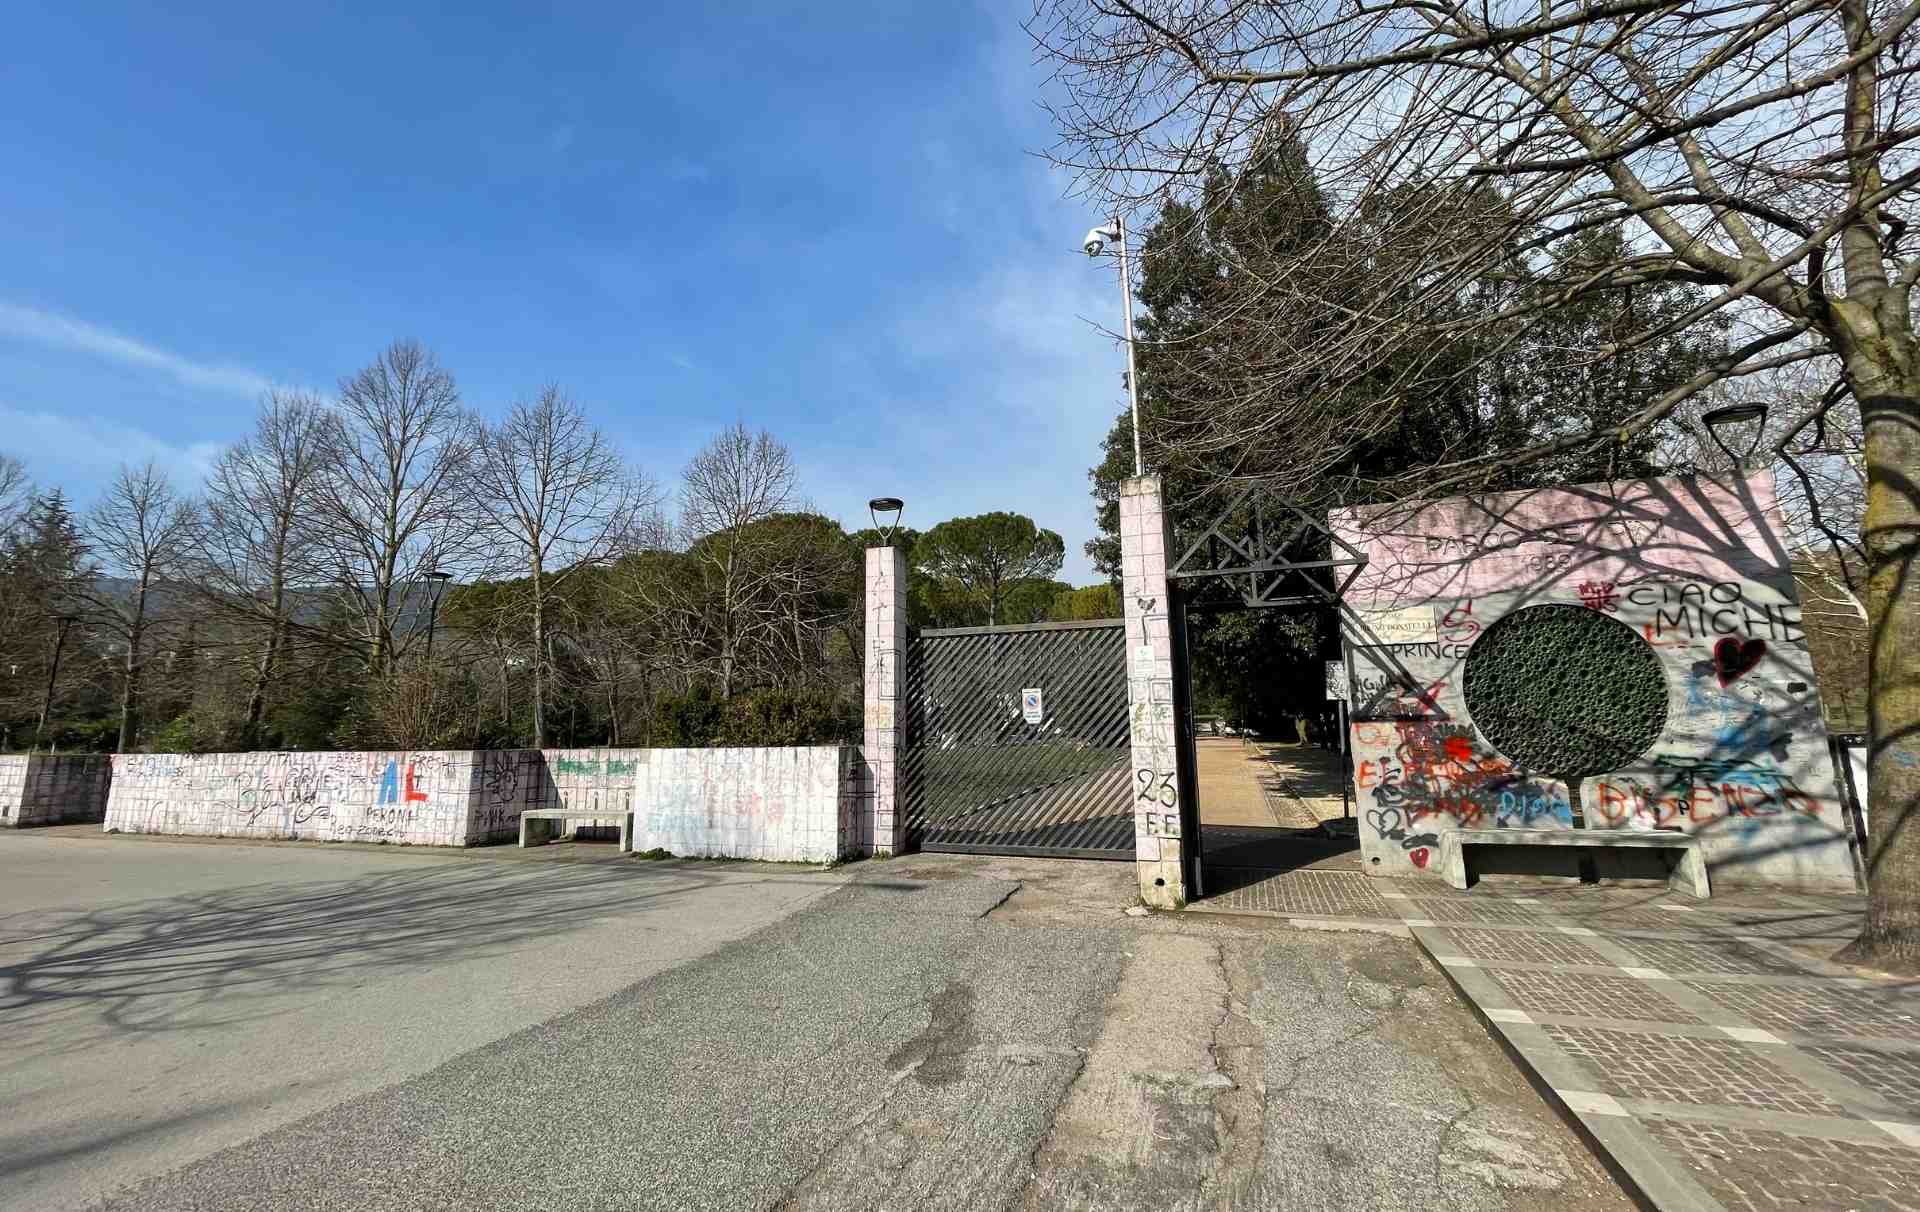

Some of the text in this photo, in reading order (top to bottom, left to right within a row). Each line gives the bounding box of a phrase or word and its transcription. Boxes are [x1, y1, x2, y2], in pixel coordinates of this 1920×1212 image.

[1627, 581, 1743, 606] CIAO
[1391, 644, 1469, 660] PRINCE
[1137, 768, 1177, 808] 23
